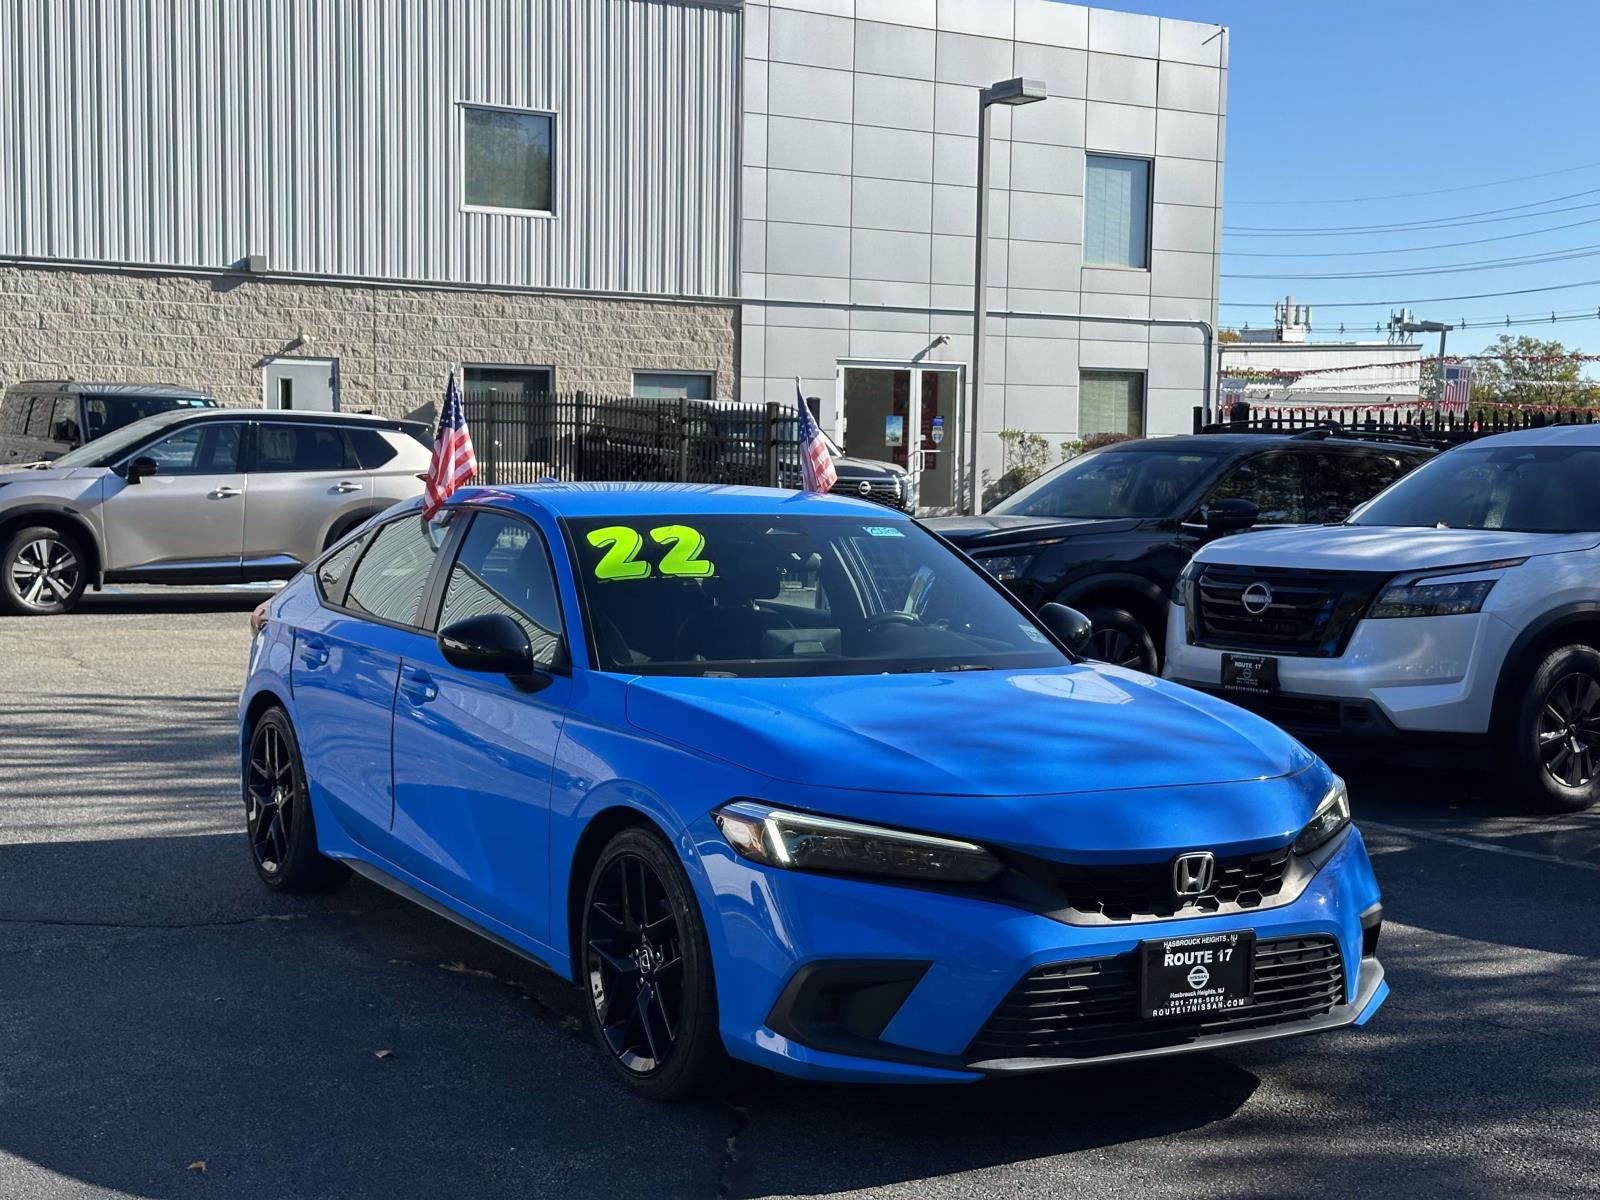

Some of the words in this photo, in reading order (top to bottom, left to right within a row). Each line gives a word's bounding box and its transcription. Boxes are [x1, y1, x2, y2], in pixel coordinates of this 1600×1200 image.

[586, 524, 715, 580] 22
[1234, 661, 1253, 669] ROUTE
[1163, 938, 1200, 948] HASBROUCK
[1164, 950, 1213, 967] ROUTE
[1217, 948, 1233, 962] 17
[1152, 998, 1245, 1017] ROUTE17NISSAN.COM
